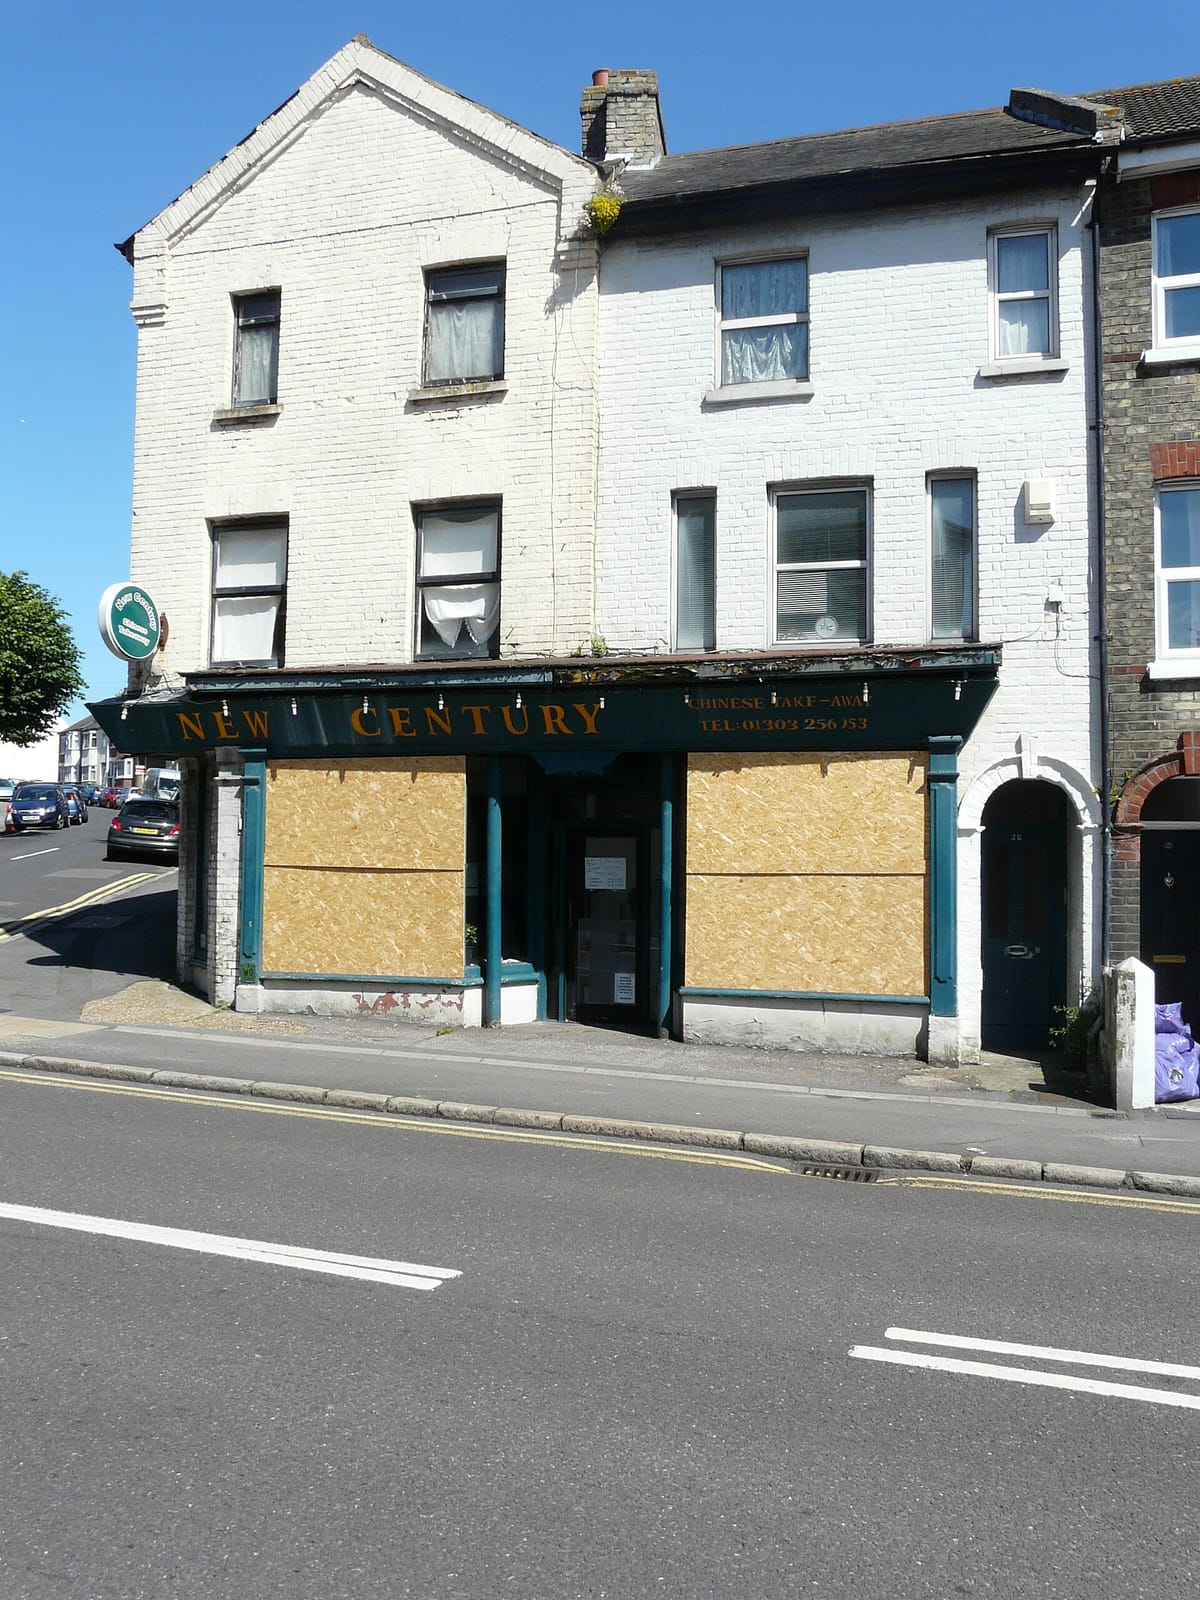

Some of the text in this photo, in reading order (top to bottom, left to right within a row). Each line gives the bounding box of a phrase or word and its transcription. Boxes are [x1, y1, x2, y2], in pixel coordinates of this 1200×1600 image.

[115, 592, 157, 631] New Century
[688, 696, 765, 710] CHINESE
[176, 703, 602, 742] NEW CENTURY
[700, 718, 799, 732] TEL:01303
